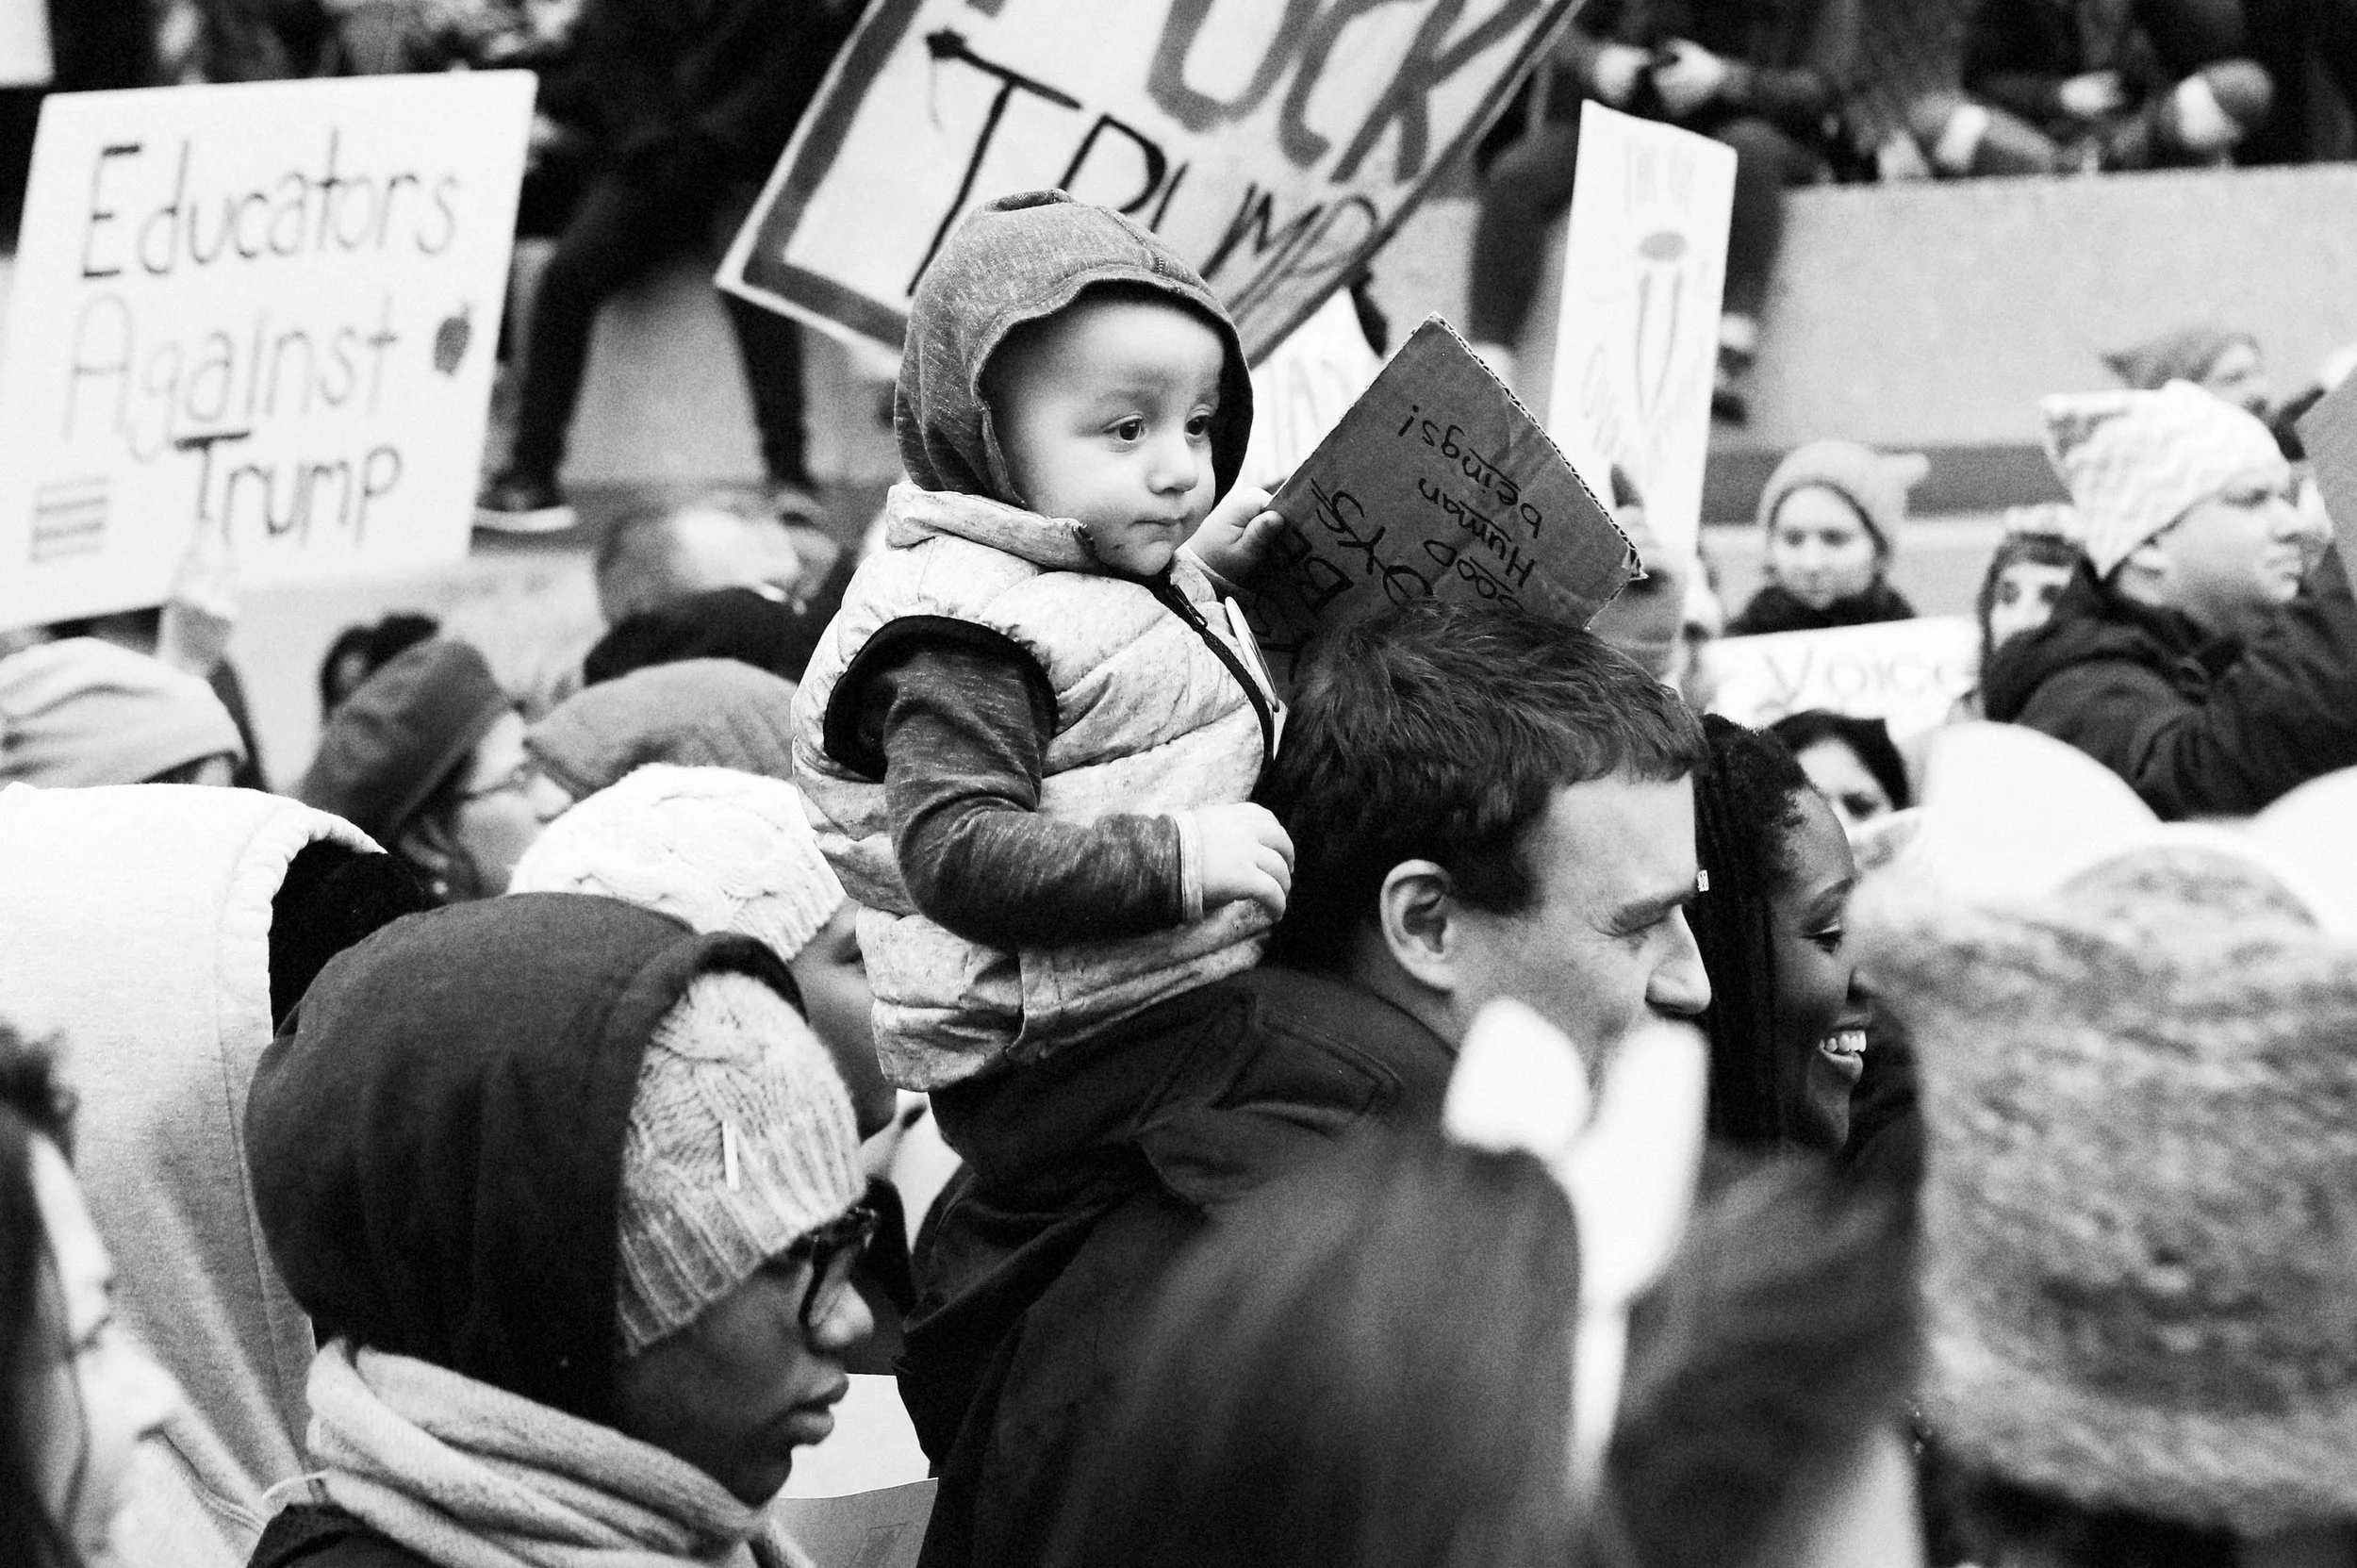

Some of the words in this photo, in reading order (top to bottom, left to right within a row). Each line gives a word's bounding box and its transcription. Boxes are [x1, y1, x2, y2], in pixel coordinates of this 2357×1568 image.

[964, 0, 1542, 183] UCK
[81, 126, 460, 279] Educators
[63, 286, 400, 463] Against
[173, 428, 402, 549] Trump
[1397, 404, 1543, 539] beings!
[1418, 477, 1536, 588] Human
[1310, 488, 1434, 606] OYS
